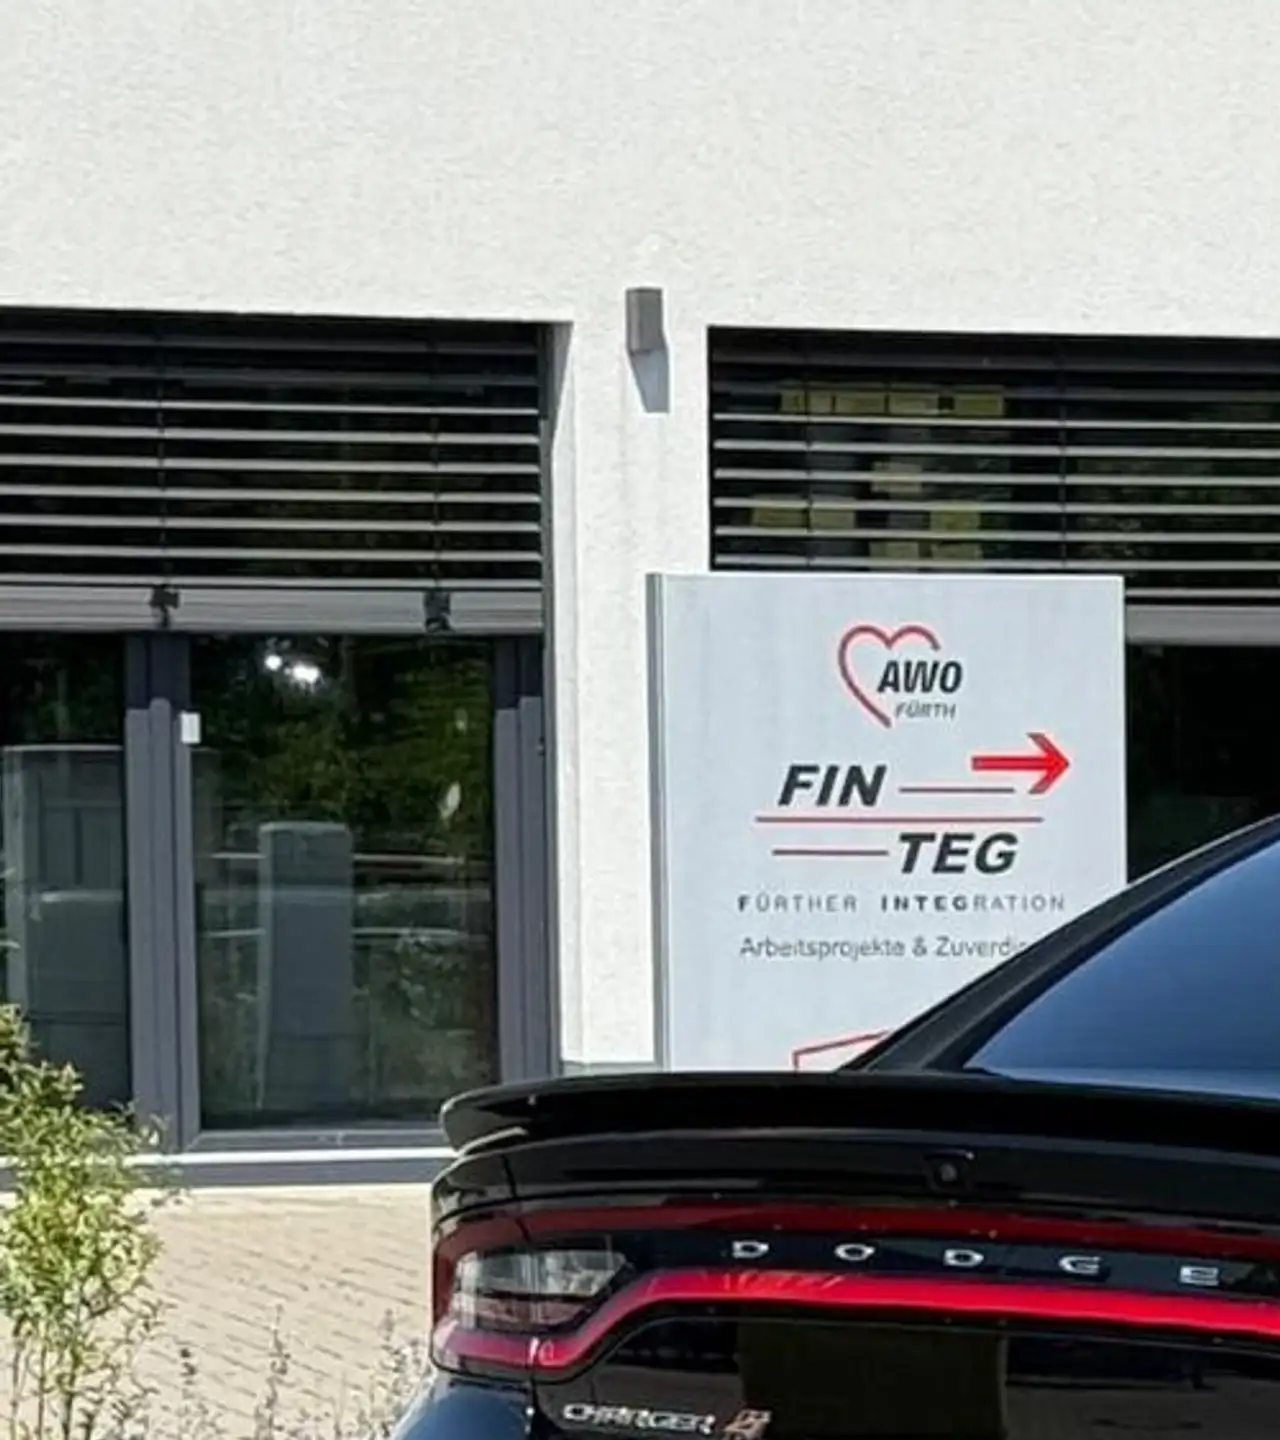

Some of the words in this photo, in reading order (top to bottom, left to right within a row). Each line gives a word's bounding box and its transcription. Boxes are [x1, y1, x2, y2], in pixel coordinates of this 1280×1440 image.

[877, 660, 963, 693] AWO
[895, 701, 956, 719] FÜRTH
[778, 764, 887, 807] FIN
[899, 832, 1019, 875] TEG
[737, 892, 857, 913] FÜRTHER
[881, 894, 1065, 913] INTEGRATION
[740, 936, 905, 962] Arbeitsprojekte
[912, 936, 927, 957] &
[732, 1239, 1220, 1287] DODGE
[563, 1402, 716, 1434] CHARGER
